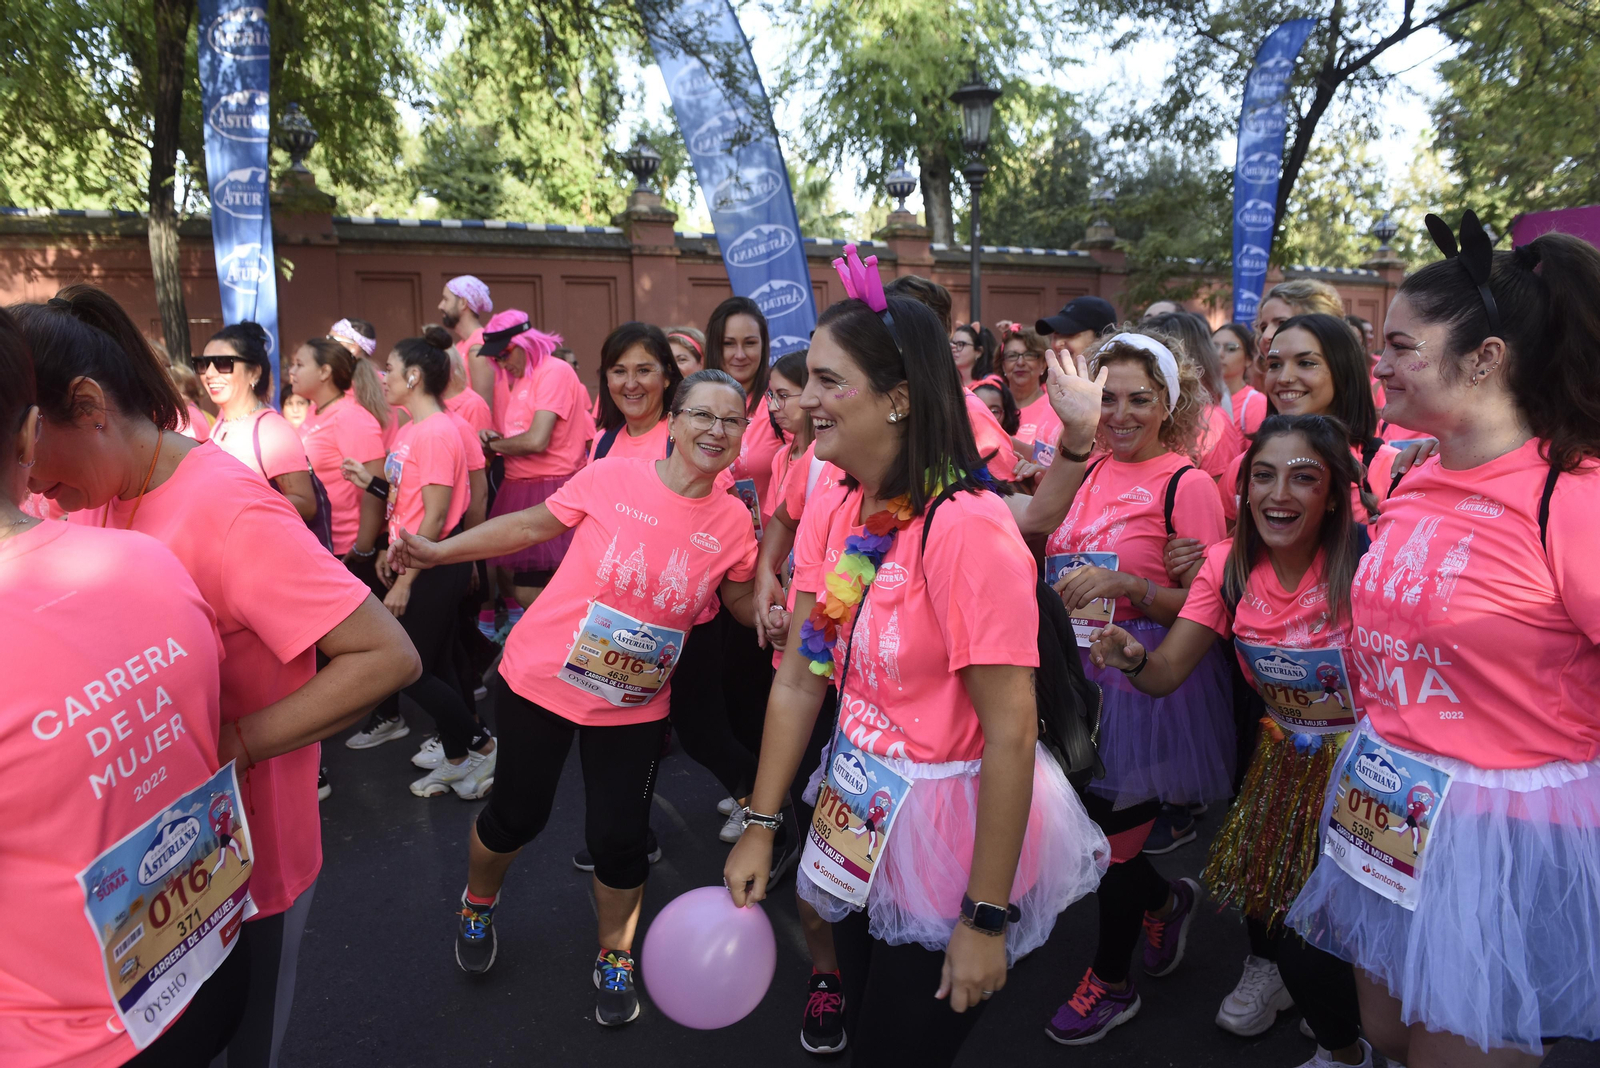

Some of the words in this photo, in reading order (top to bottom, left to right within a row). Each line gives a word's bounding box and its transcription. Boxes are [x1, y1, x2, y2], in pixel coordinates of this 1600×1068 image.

[615, 502, 658, 527] OYSHO
[1457, 502, 1499, 517] ASTURIANA
[1070, 618, 1088, 626] MUJER
[614, 633, 654, 651] ASTURIANA
[1357, 625, 1452, 666] DORSAL
[604, 650, 647, 674] 016
[607, 670, 629, 682] 4630
[1257, 661, 1304, 678] ASTURIANA
[31, 636, 188, 741] CARRERA
[568, 673, 599, 691] OYSHO
[584, 671, 608, 683] CARRERA
[609, 679, 617, 687] DE
[625, 684, 642, 692] MUJER
[1263, 682, 1310, 706] 016
[85, 710, 133, 758] DE
[141, 685, 173, 723] LA
[1278, 706, 1302, 717] 5389
[1439, 711, 1464, 720] 2022
[88, 712, 187, 800] MUJER
[132, 765, 168, 802] 2022
[833, 757, 864, 793] ASTURIANA
[1355, 758, 1397, 791] ASTURIANA
[820, 785, 851, 828] 016
[1348, 787, 1390, 829] 016
[815, 817, 832, 840] 5393
[1352, 820, 1375, 843] 5395
[143, 826, 198, 883] ASTURIANA
[813, 834, 820, 845] DE
[818, 839, 825, 850] LA
[824, 844, 845, 866] MUJER
[1336, 823, 1355, 844] CARRERA
[1355, 838, 1364, 848] DE
[1362, 842, 1370, 853] LA
[1371, 847, 1395, 866] MUJER
[96, 875, 129, 902] SUMA
[148, 859, 208, 929] 016
[820, 865, 856, 894] Santander
[1370, 868, 1407, 894] Santander
[176, 908, 202, 937] 371
[148, 943, 187, 982] CARRERA
[187, 933, 199, 948] DE
[200, 922, 209, 936] LA
[210, 898, 235, 926] MUJER
[144, 971, 187, 1024] OYSHO
